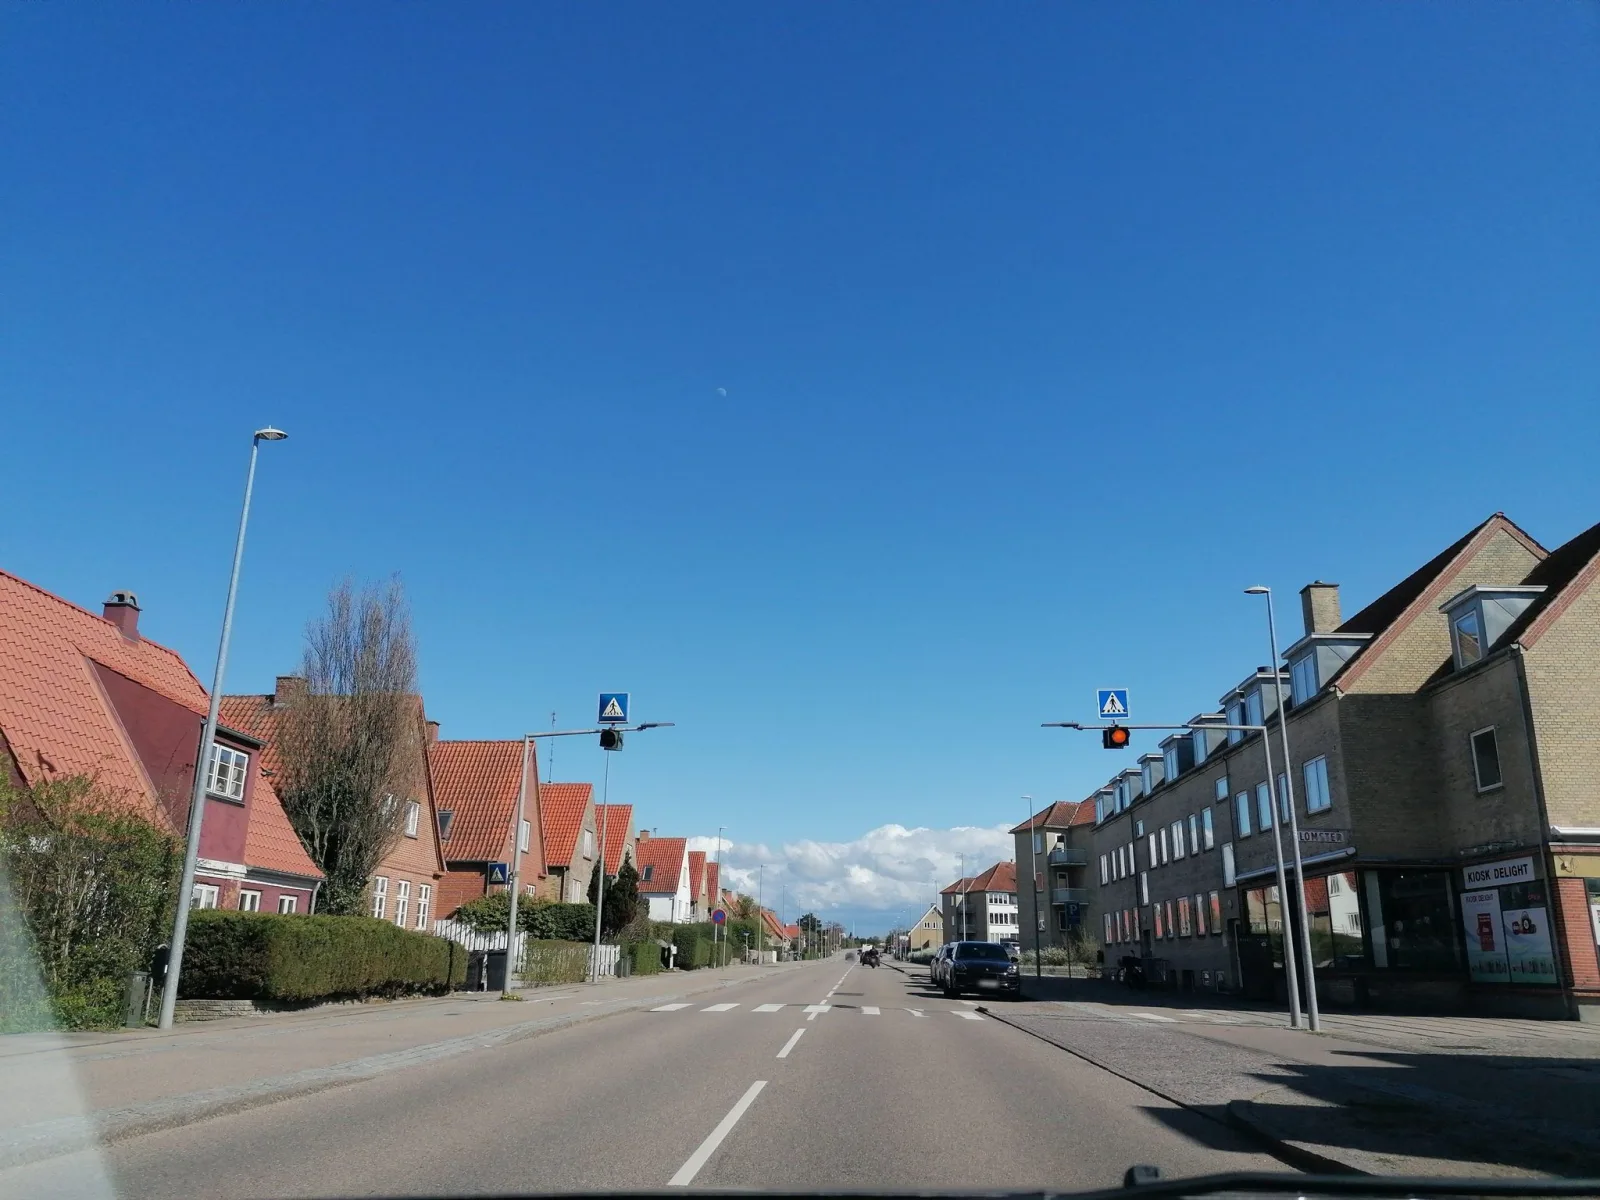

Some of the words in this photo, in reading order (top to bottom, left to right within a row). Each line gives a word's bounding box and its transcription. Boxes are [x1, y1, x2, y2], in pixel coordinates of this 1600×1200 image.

[1299, 832, 1344, 842] LOMSTER
[1468, 869, 1491, 883] KIOSK
[1494, 864, 1528, 879] DELIGHT
[1070, 904, 1078, 915] P
